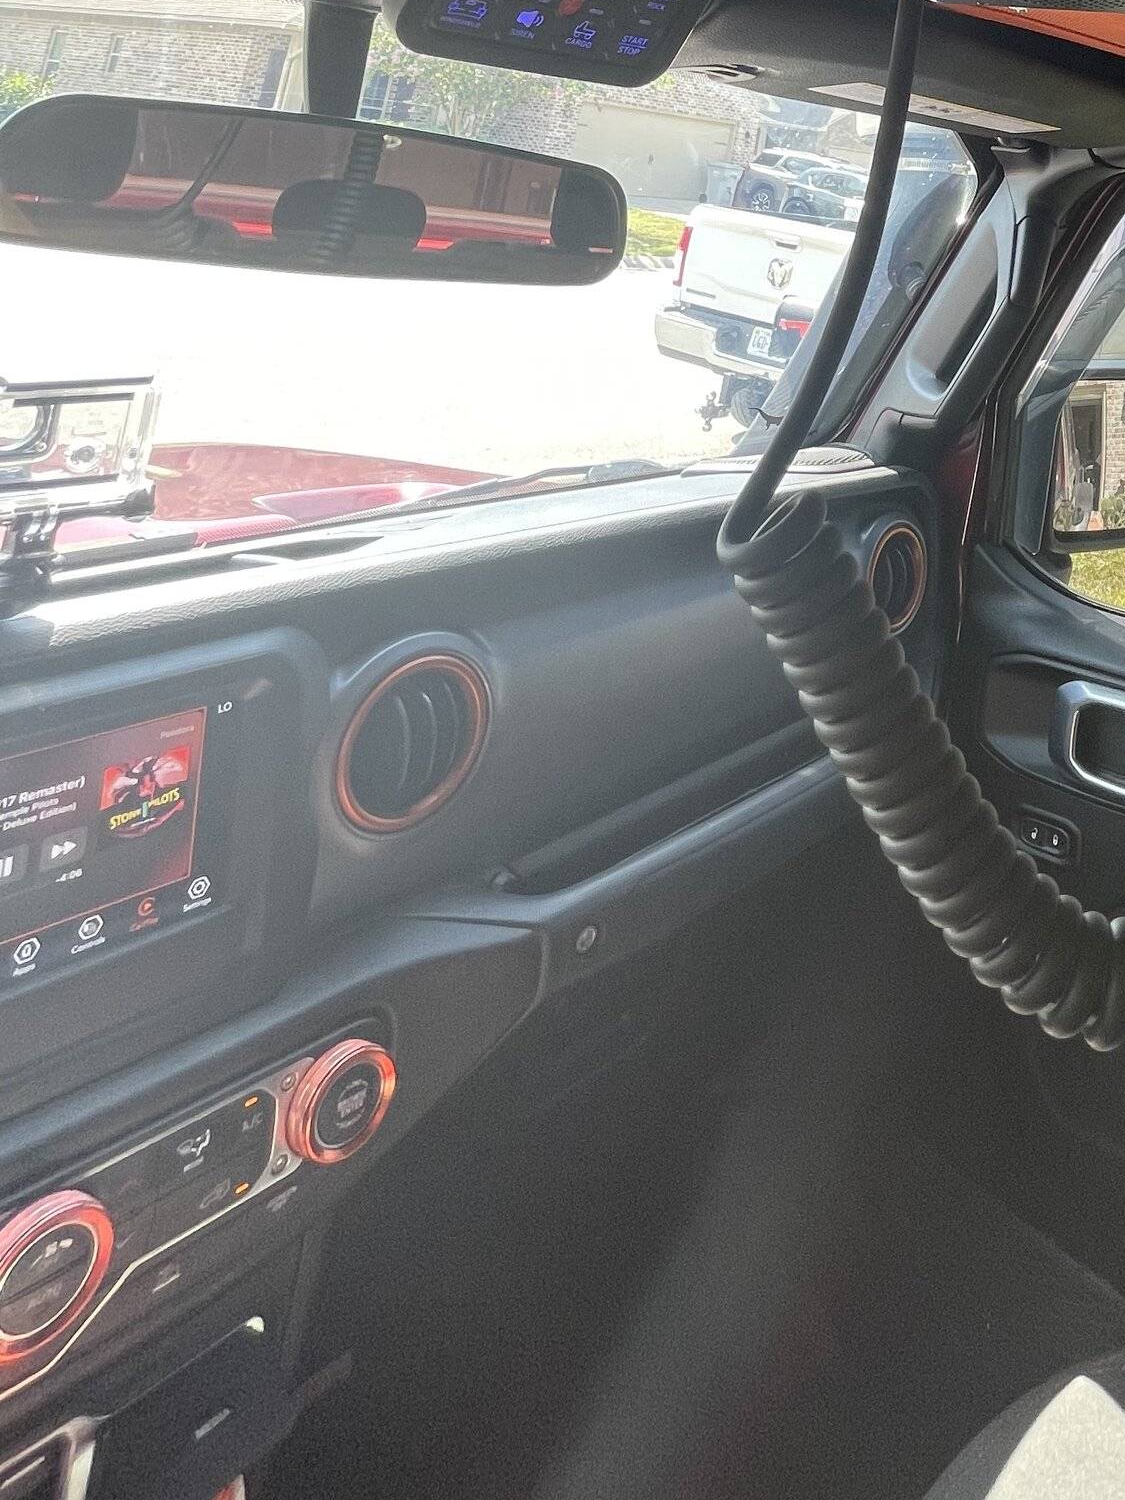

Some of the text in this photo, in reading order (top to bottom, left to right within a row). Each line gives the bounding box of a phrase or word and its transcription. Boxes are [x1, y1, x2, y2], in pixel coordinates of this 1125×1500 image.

[511, 28, 535, 40] SIREN
[565, 37, 592, 49] CARGO
[621, 35, 649, 46] START
[617, 45, 641, 56] STOP
[217, 701, 233, 714] LO
[0, 775, 86, 809] 17 Remaster)
